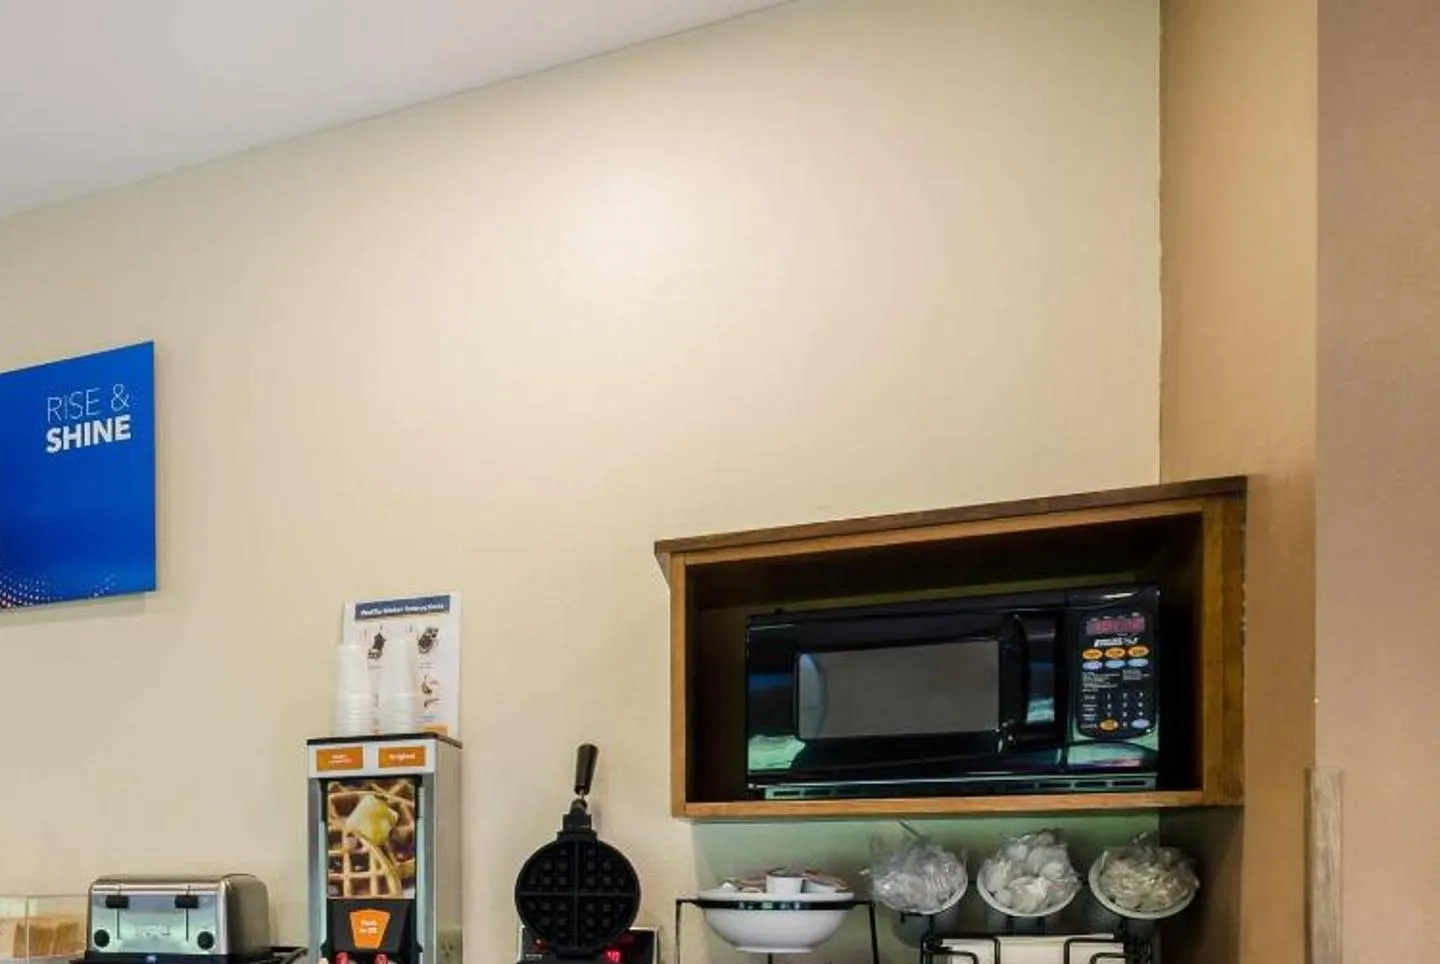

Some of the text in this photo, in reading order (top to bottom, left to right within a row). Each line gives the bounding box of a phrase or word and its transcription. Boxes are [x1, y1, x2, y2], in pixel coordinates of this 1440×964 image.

[47, 383, 130, 423] RISE &
[46, 414, 131, 453] SHINE
